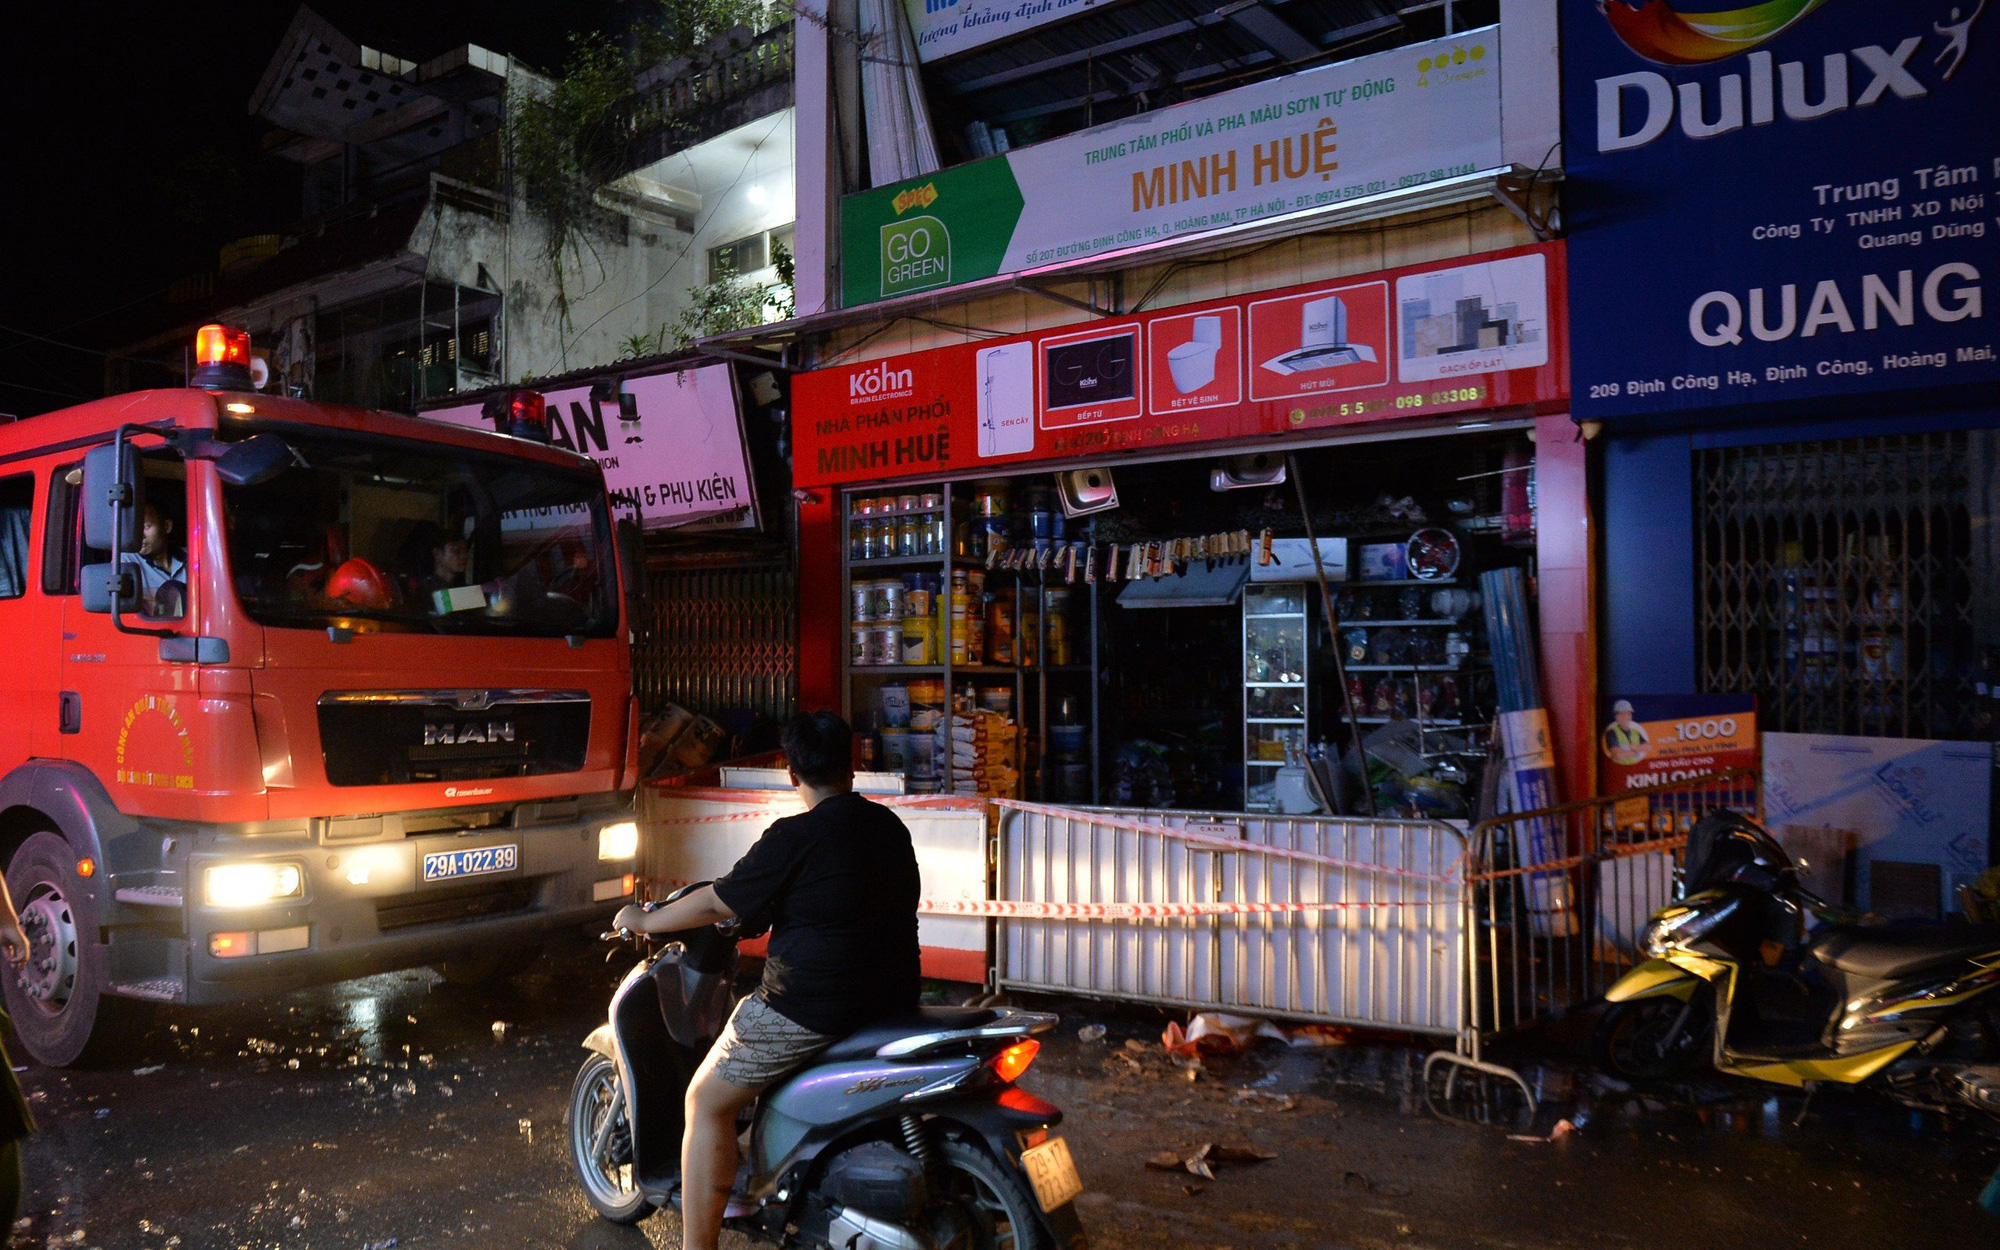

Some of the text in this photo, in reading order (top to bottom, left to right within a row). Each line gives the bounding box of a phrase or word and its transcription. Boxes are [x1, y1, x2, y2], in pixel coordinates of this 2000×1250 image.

[1595, 35, 1928, 153] Dulux
[1085, 77, 1396, 165] TRUNG TÂM PHỐI VÀ PHA MÀU SƠN TỰ ĐỘNG
[1132, 117, 1338, 212] MINH HUỆ
[1813, 178, 1900, 205] Trung
[1913, 165, 1978, 190] Tâm
[1040, 250, 1055, 262] 207
[1117, 229, 1142, 244] CÔNG
[1235, 208, 1247, 219] TP
[1752, 224, 1801, 240] Công
[1810, 218, 1835, 234] Ty
[1847, 206, 1902, 227] TNHH
[1911, 201, 1941, 218] XD
[1950, 194, 1984, 213] Nội
[1858, 231, 1922, 249] Quang
[1932, 221, 1985, 240] Dũng
[888, 228, 930, 263] GO
[888, 256, 944, 283] GREEN
[1688, 262, 1983, 347] QUANG
[850, 361, 913, 397] Köhn
[1589, 344, 1997, 398] 209 Định Công Hạ, Định Công, Hoàng Mai,
[816, 395, 950, 436] NHÀ PHÂN PHỐI
[850, 390, 913, 405] BRAUN ELECTRONICS
[1199, 394, 1219, 404] SINH
[818, 425, 950, 475] MINH HUỆ
[643, 485, 657, 507] &
[659, 481, 694, 508] PHỤ
[697, 472, 737, 506] KIỆN
[424, 722, 516, 745] MAN
[1675, 718, 1738, 742] 1000
[457, 787, 494, 797] rosenbauer
[1626, 772, 1659, 789] KIM
[427, 848, 515, 880] 29A-022.89
